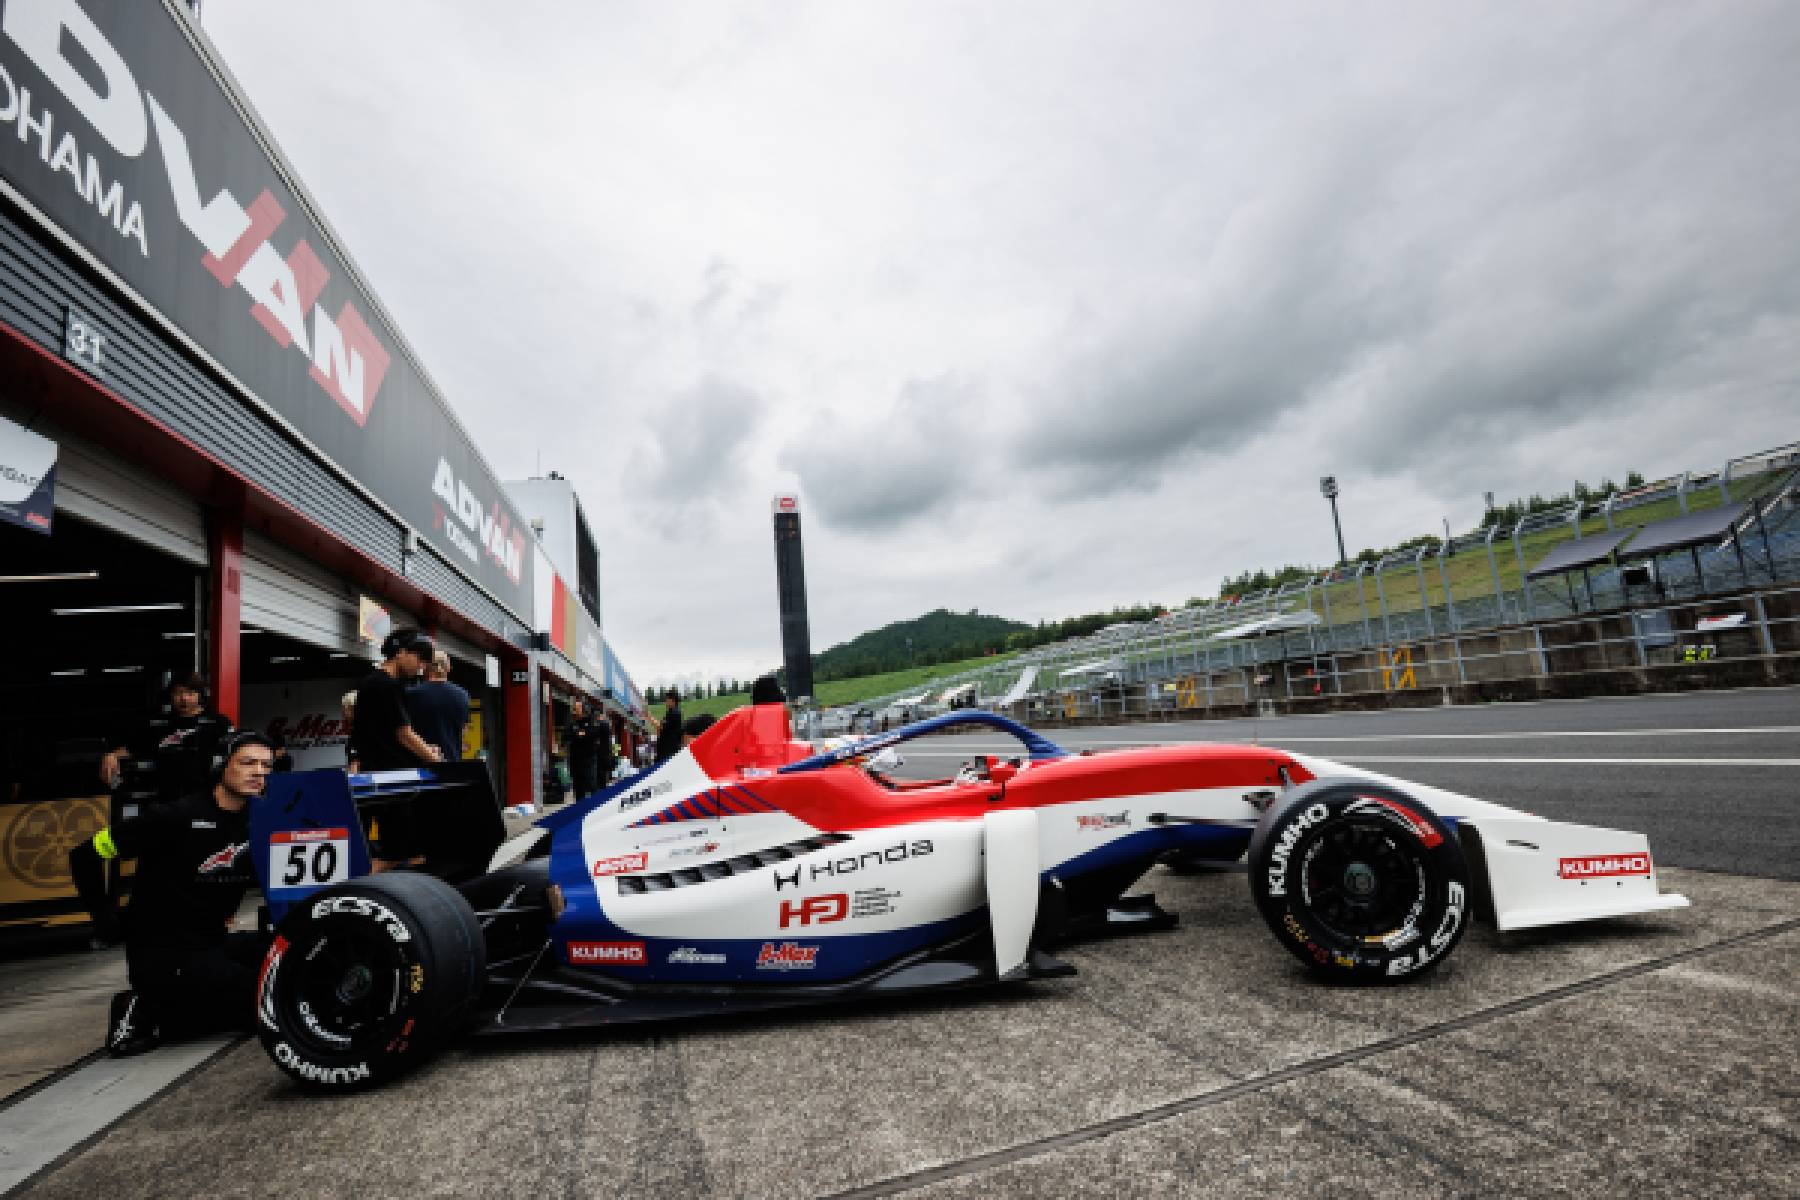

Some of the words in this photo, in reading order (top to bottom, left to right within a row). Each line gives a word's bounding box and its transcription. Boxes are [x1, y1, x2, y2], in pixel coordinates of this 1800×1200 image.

[72, 323, 99, 363] 31
[432, 456, 521, 583] ADVAN
[284, 843, 337, 885] 50
[809, 838, 934, 881] Honda
[1269, 802, 1330, 896] KUMHO
[1561, 856, 1646, 875] KUMHO
[572, 946, 643, 961] KUMHO
[274, 1042, 370, 1083] KUMHO
